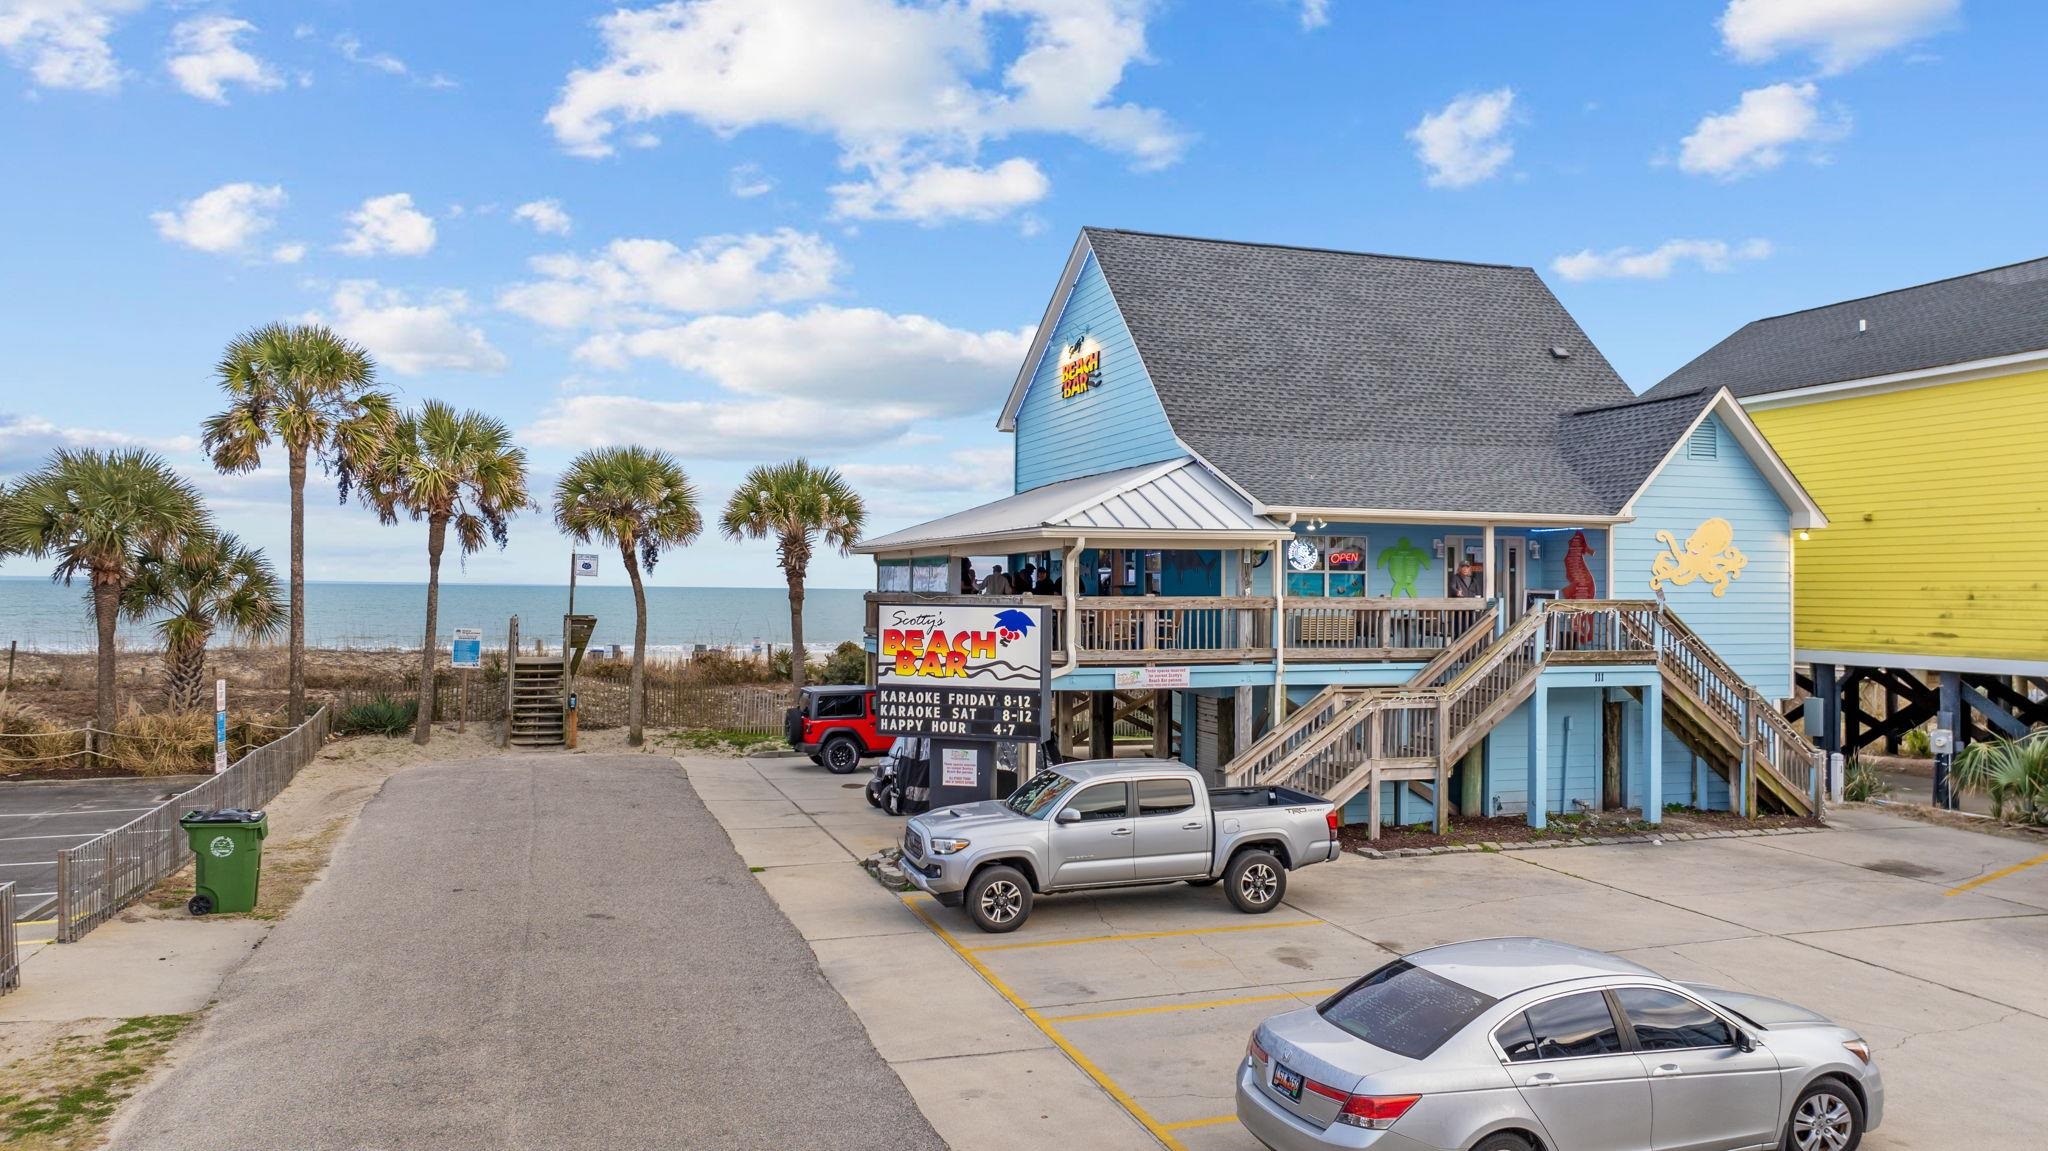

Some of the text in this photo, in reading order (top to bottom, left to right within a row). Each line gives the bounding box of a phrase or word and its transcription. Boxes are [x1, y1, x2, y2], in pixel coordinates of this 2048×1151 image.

[1062, 351, 1100, 382] BEACH
[1062, 373, 1089, 398] BAR
[1330, 552, 1359, 564] OPEN
[891, 610, 945, 635] Scotty's
[883, 629, 997, 659] BEACH
[895, 650, 968, 678] BAR
[880, 690, 1031, 708] KARAOKE FRIDAY 8-12
[880, 705, 1032, 723] KARAOKE SAT 8-12
[881, 719, 1015, 736] HAPPY HOUR 4-7
